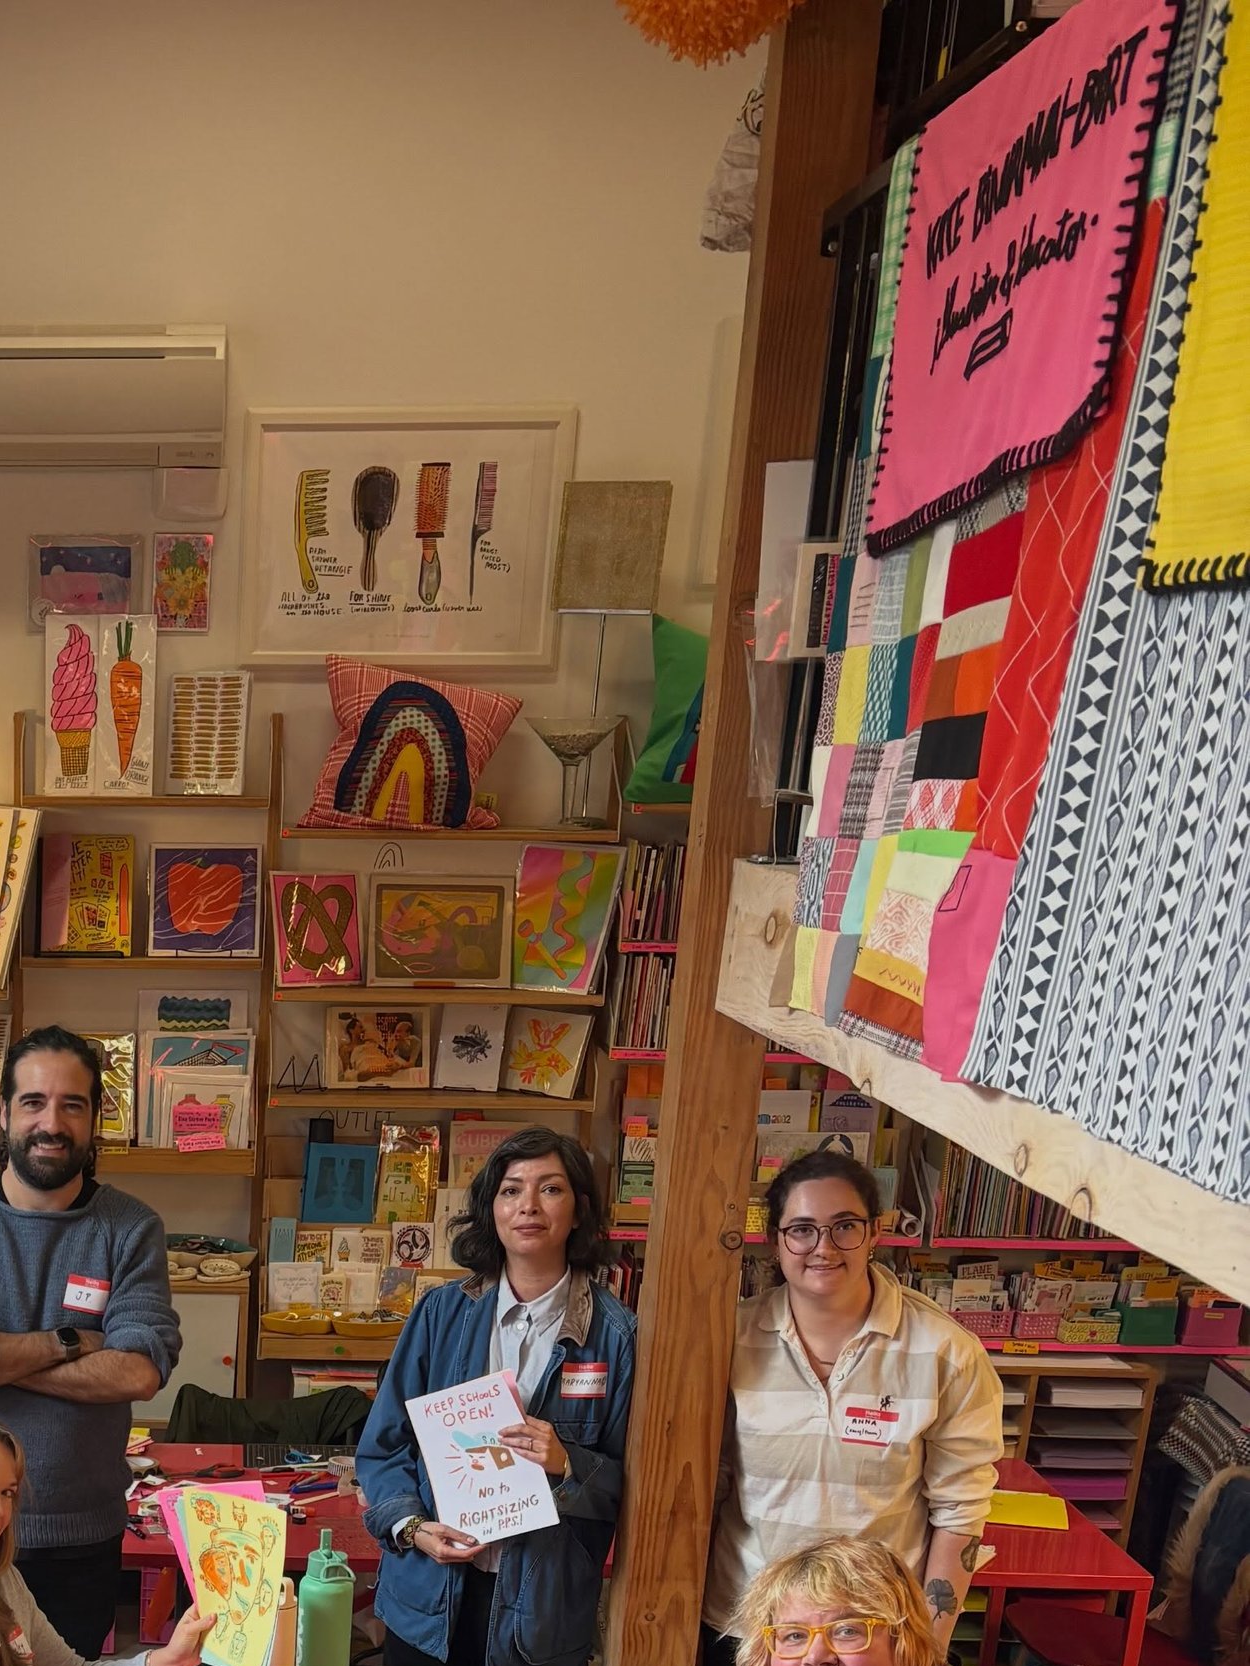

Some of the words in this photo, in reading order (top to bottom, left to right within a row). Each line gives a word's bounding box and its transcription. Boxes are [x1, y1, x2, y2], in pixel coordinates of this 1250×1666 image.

[962, 1264, 993, 1276] PLANE
[424, 1397, 454, 1418] KEEP
[458, 1384, 501, 1406] SCHOOLS
[443, 1405, 495, 1427] OPEN!
[852, 1418, 877, 1426] ANNA
